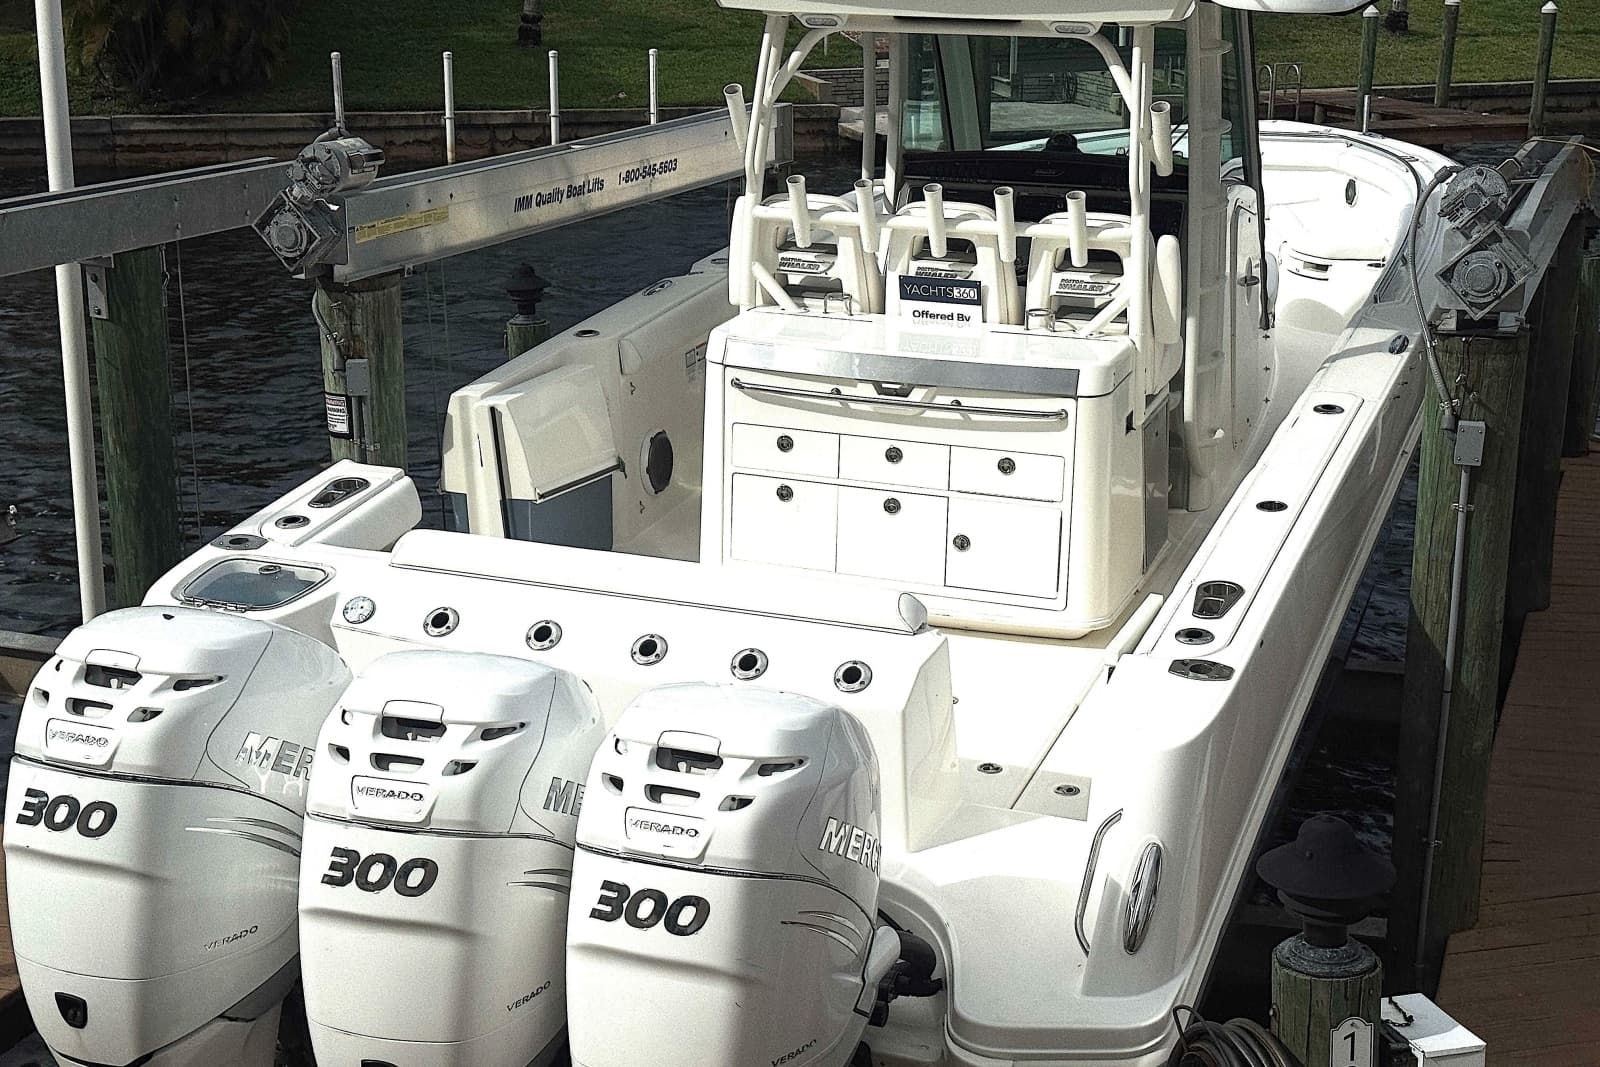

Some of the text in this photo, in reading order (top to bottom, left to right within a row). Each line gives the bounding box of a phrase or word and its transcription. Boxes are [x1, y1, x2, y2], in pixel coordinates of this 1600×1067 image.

[514, 158, 678, 213] IMM Quality Boat Lifts 1-800-545-5603
[912, 309, 954, 321] Offered
[49, 729, 109, 748] VERADO
[356, 785, 424, 801] VERADO
[16, 787, 118, 838] 300
[629, 819, 700, 837] VERADO
[321, 846, 439, 897] 300
[589, 880, 711, 936] 300
[204, 925, 258, 951] VERADO
[507, 980, 551, 1011] VERADO
[771, 1039, 817, 1067] VERADO
